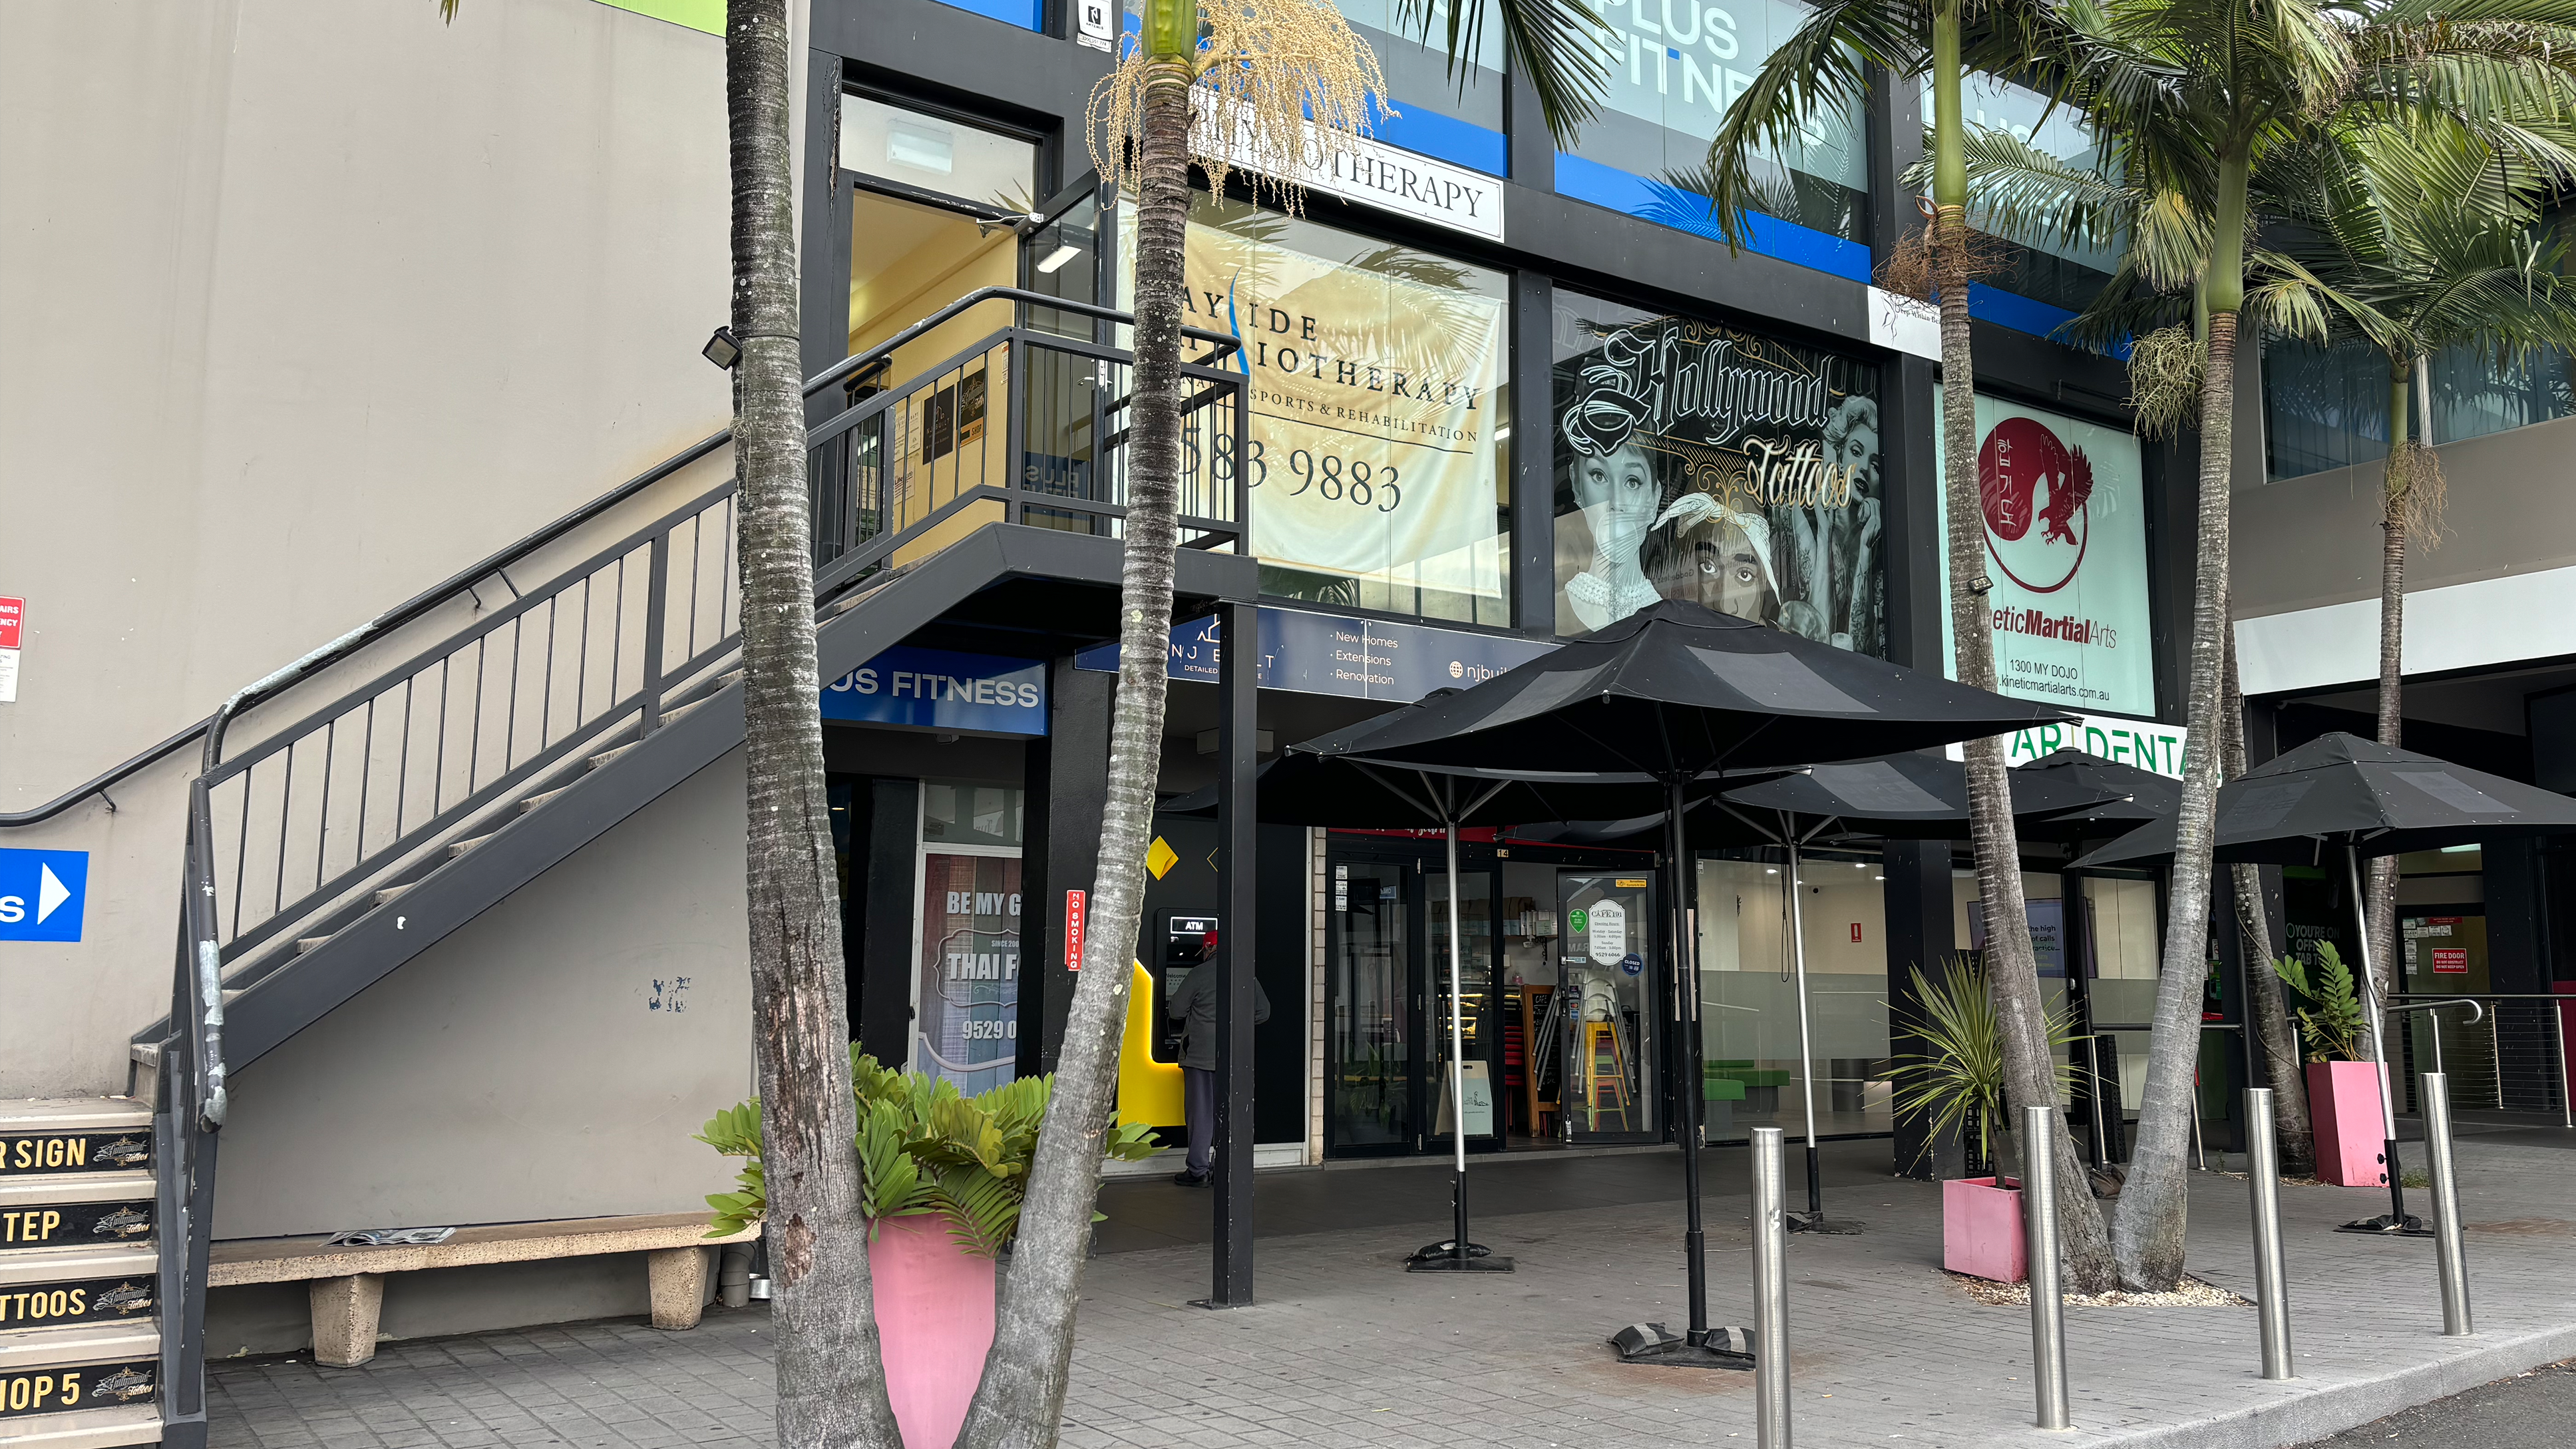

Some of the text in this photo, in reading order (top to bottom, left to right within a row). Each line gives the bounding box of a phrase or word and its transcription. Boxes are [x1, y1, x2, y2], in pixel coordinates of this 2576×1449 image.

[1594, 0, 1739, 60] LUS
[1562, 325, 1839, 456] Hollywood
[1250, 389, 1477, 442] SPORTS & REHABILITATION
[1179, 427, 1401, 512] 583 9883
[1741, 435, 1857, 509] Tattoos
[1998, 439, 2017, 526] 합기도
[1336, 631, 1398, 648] New Homes
[1185, 665, 1218, 674] DETAILED
[1336, 650, 1391, 666] Extensions
[2010, 659, 2078, 680] 1300 MY DOJO
[830, 668, 1038, 708] US FITNESS
[1336, 669, 1394, 685] Renovation
[1997, 674, 2110, 700] .kineticmartialarts.com.au
[2086, 726, 2220, 779] DENT
[947, 891, 971, 914] BE
[975, 893, 1005, 915] MY
[1072, 893, 1079, 909] NO
[1070, 912, 1079, 968] SMOKING
[1185, 921, 1204, 931] ATM
[2295, 925, 2325, 938] YOU'RE
[2297, 938, 2316, 952] OFFI
[948, 953, 1000, 980] THAI
[962, 1020, 1004, 1039] 9529
[15, 1138, 86, 1168] SIGN
[3, 1211, 61, 1242] TEP
[0, 1289, 86, 1322] TTOOS
[61, 1372, 81, 1405] 5
